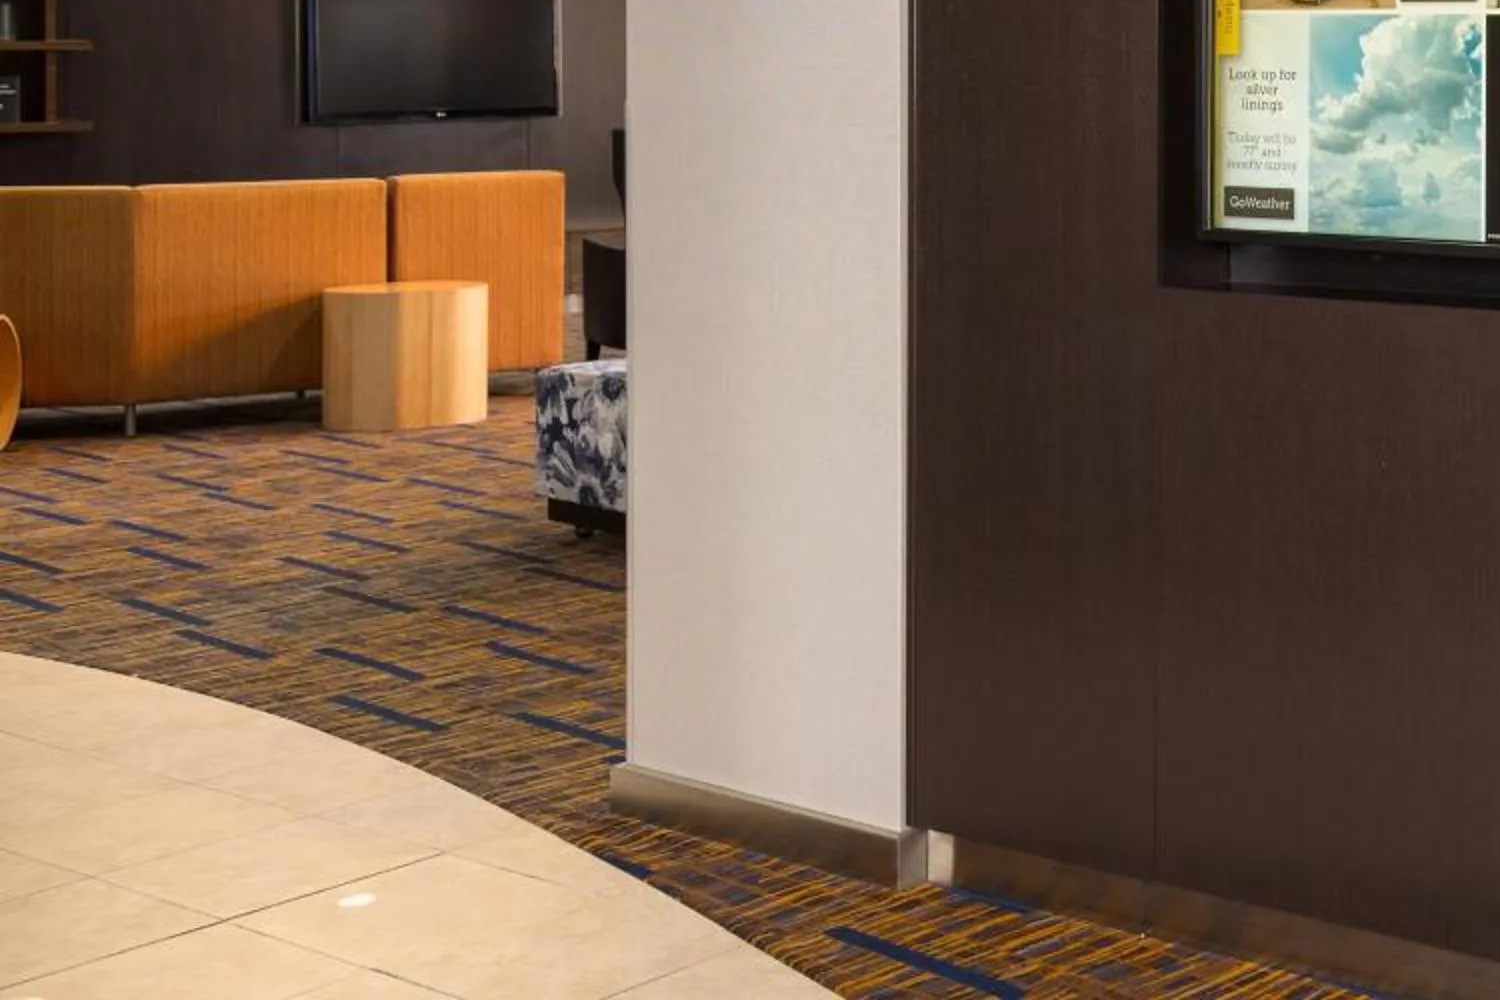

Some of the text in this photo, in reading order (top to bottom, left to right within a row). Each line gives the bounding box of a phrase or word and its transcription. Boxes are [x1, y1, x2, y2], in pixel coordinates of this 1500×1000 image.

[1228, 67, 1297, 85] Look up for
[1246, 83, 1278, 96] silver
[1241, 98, 1283, 113] linings
[1261, 148, 1281, 157] and
[1229, 195, 1291, 211] GoWeather
